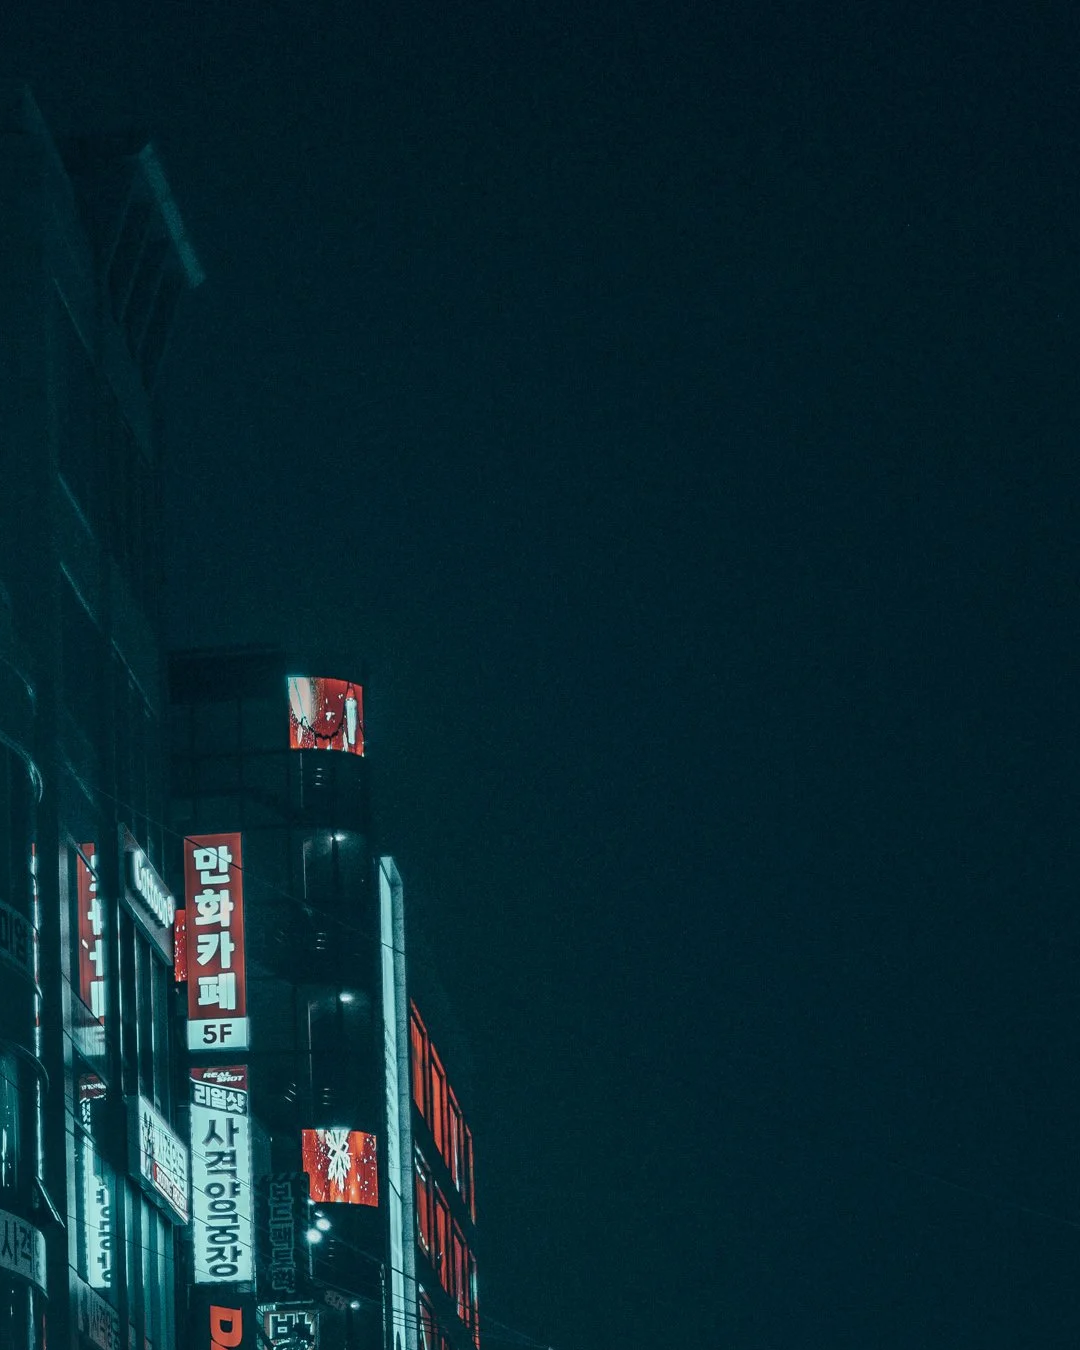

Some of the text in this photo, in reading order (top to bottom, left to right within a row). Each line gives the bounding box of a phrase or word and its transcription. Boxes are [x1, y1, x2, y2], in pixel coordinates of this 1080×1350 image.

[193, 846, 236, 1010] 만화카페
[203, 1024, 232, 1044] 5F
[194, 1084, 245, 1113] 리얼샷
[202, 1118, 242, 1278] 사격양궁장
